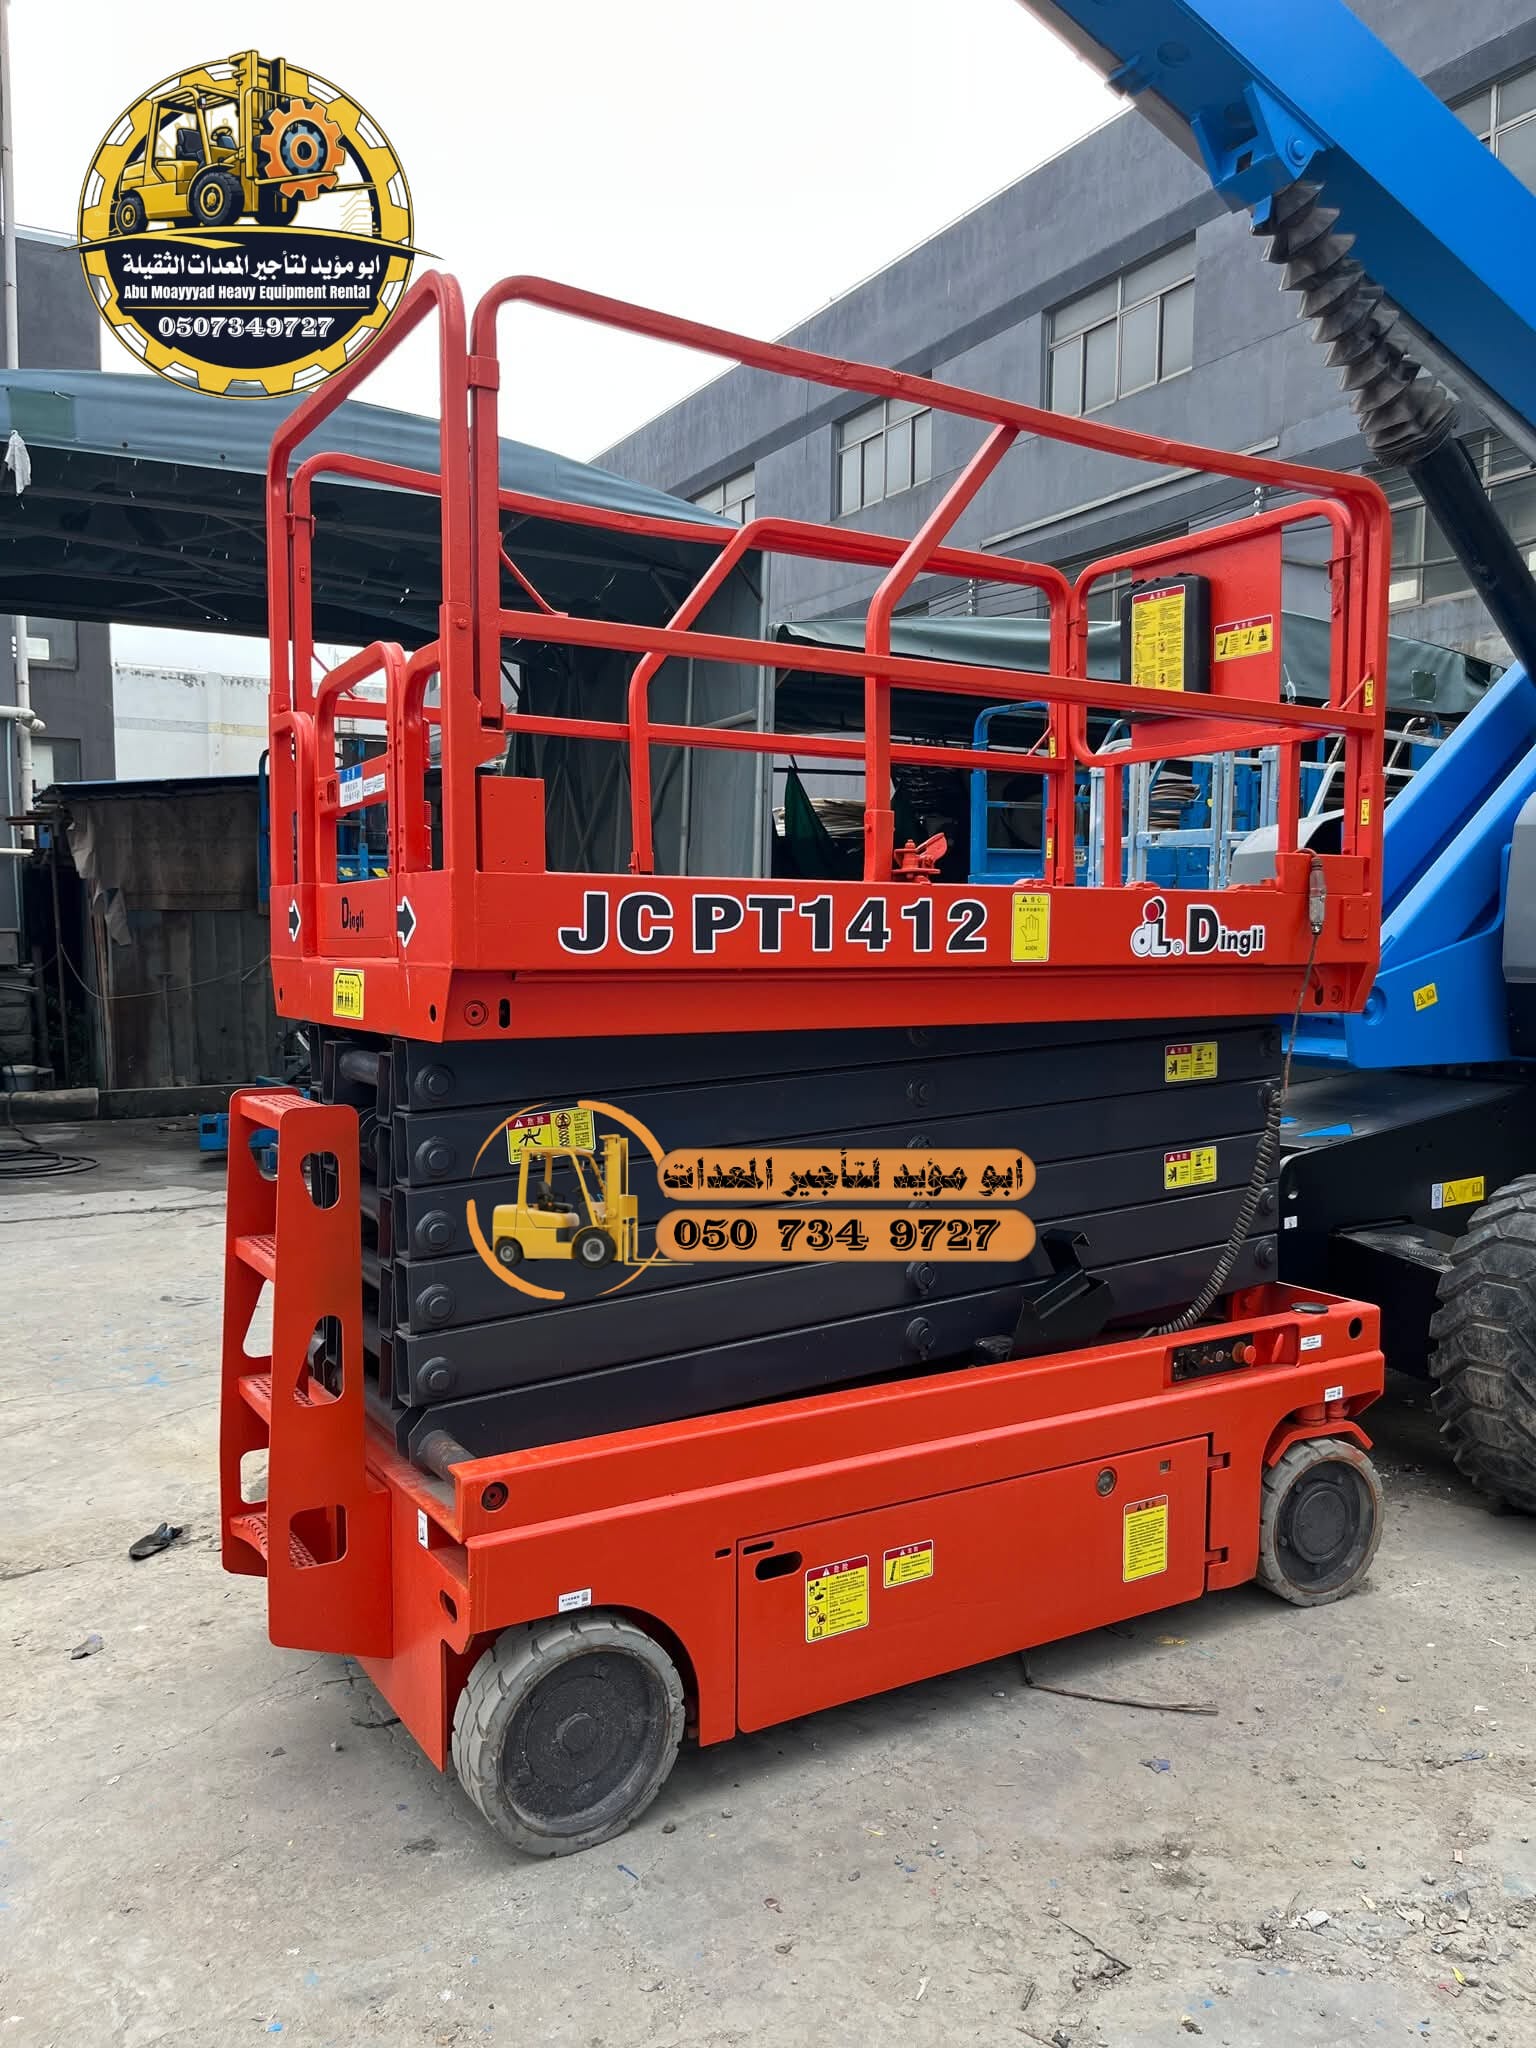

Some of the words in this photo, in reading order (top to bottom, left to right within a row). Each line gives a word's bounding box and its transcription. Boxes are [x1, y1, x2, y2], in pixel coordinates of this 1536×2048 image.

[341, 896, 365, 933] Dingli
[558, 891, 673, 954] JC
[692, 894, 988, 954] PT1412
[1186, 904, 1265, 957] Dingli
